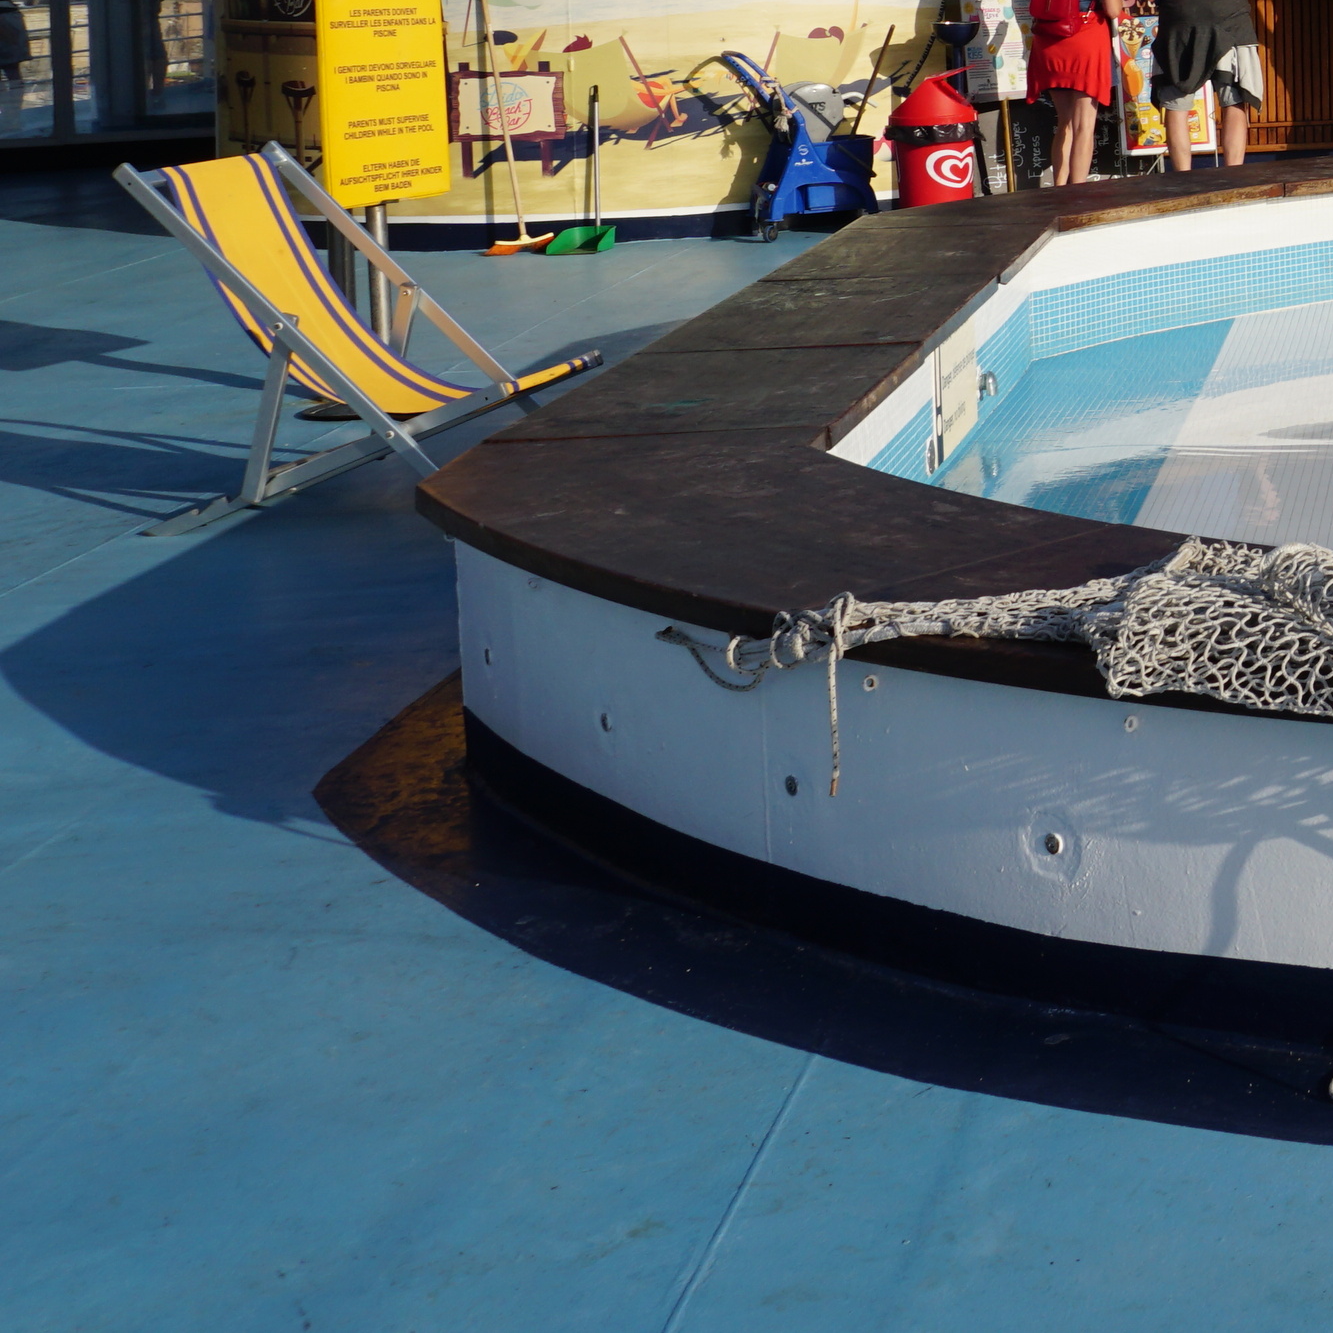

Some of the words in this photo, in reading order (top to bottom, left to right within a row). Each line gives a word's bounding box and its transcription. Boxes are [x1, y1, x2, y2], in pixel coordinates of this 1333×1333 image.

[349, 10, 362, 18] LES
[363, 9, 391, 17] PARENTS
[392, 8, 418, 16] DOIVENT
[330, 20, 369, 29] SURVEILLER
[370, 19, 382, 27] LES
[383, 18, 410, 27] ENFANTS
[411, 18, 427, 26] DANS
[428, 17, 436, 25] LA
[373, 29, 397, 37] PISCINE
[337, 65, 368, 74] GENITORI
[368, 62, 394, 72] DEVONO
[396, 60, 437, 70] SORVEGLIARE
[349, 74, 375, 84] BAMBINI
[376, 72, 402, 82] QUANDO
[403, 71, 421, 80] SONO
[376, 83, 401, 92] PISCINA
[348, 118, 377, 129] PARENTS
[378, 117, 396, 126] MUST
[396, 114, 429, 124] SUPERVISE
[344, 129, 376, 140] CHILDREN
[377, 127, 397, 137] WHILE
[397, 126, 404, 135] IN
[405, 125, 417, 134] THE
[417, 124, 434, 133] POOL
[1027, 135, 1047, 179] Express
[363, 162, 387, 172] ELTERN
[388, 160, 409, 170] HABEN
[410, 158, 421, 167] DIE
[340, 171, 401, 186] AUFSICHTSPFLICHT
[401, 169, 420, 178] IHRER
[421, 166, 443, 176] KINDER
[374, 182, 390, 192] BEIM
[391, 180, 412, 190] BADEN
